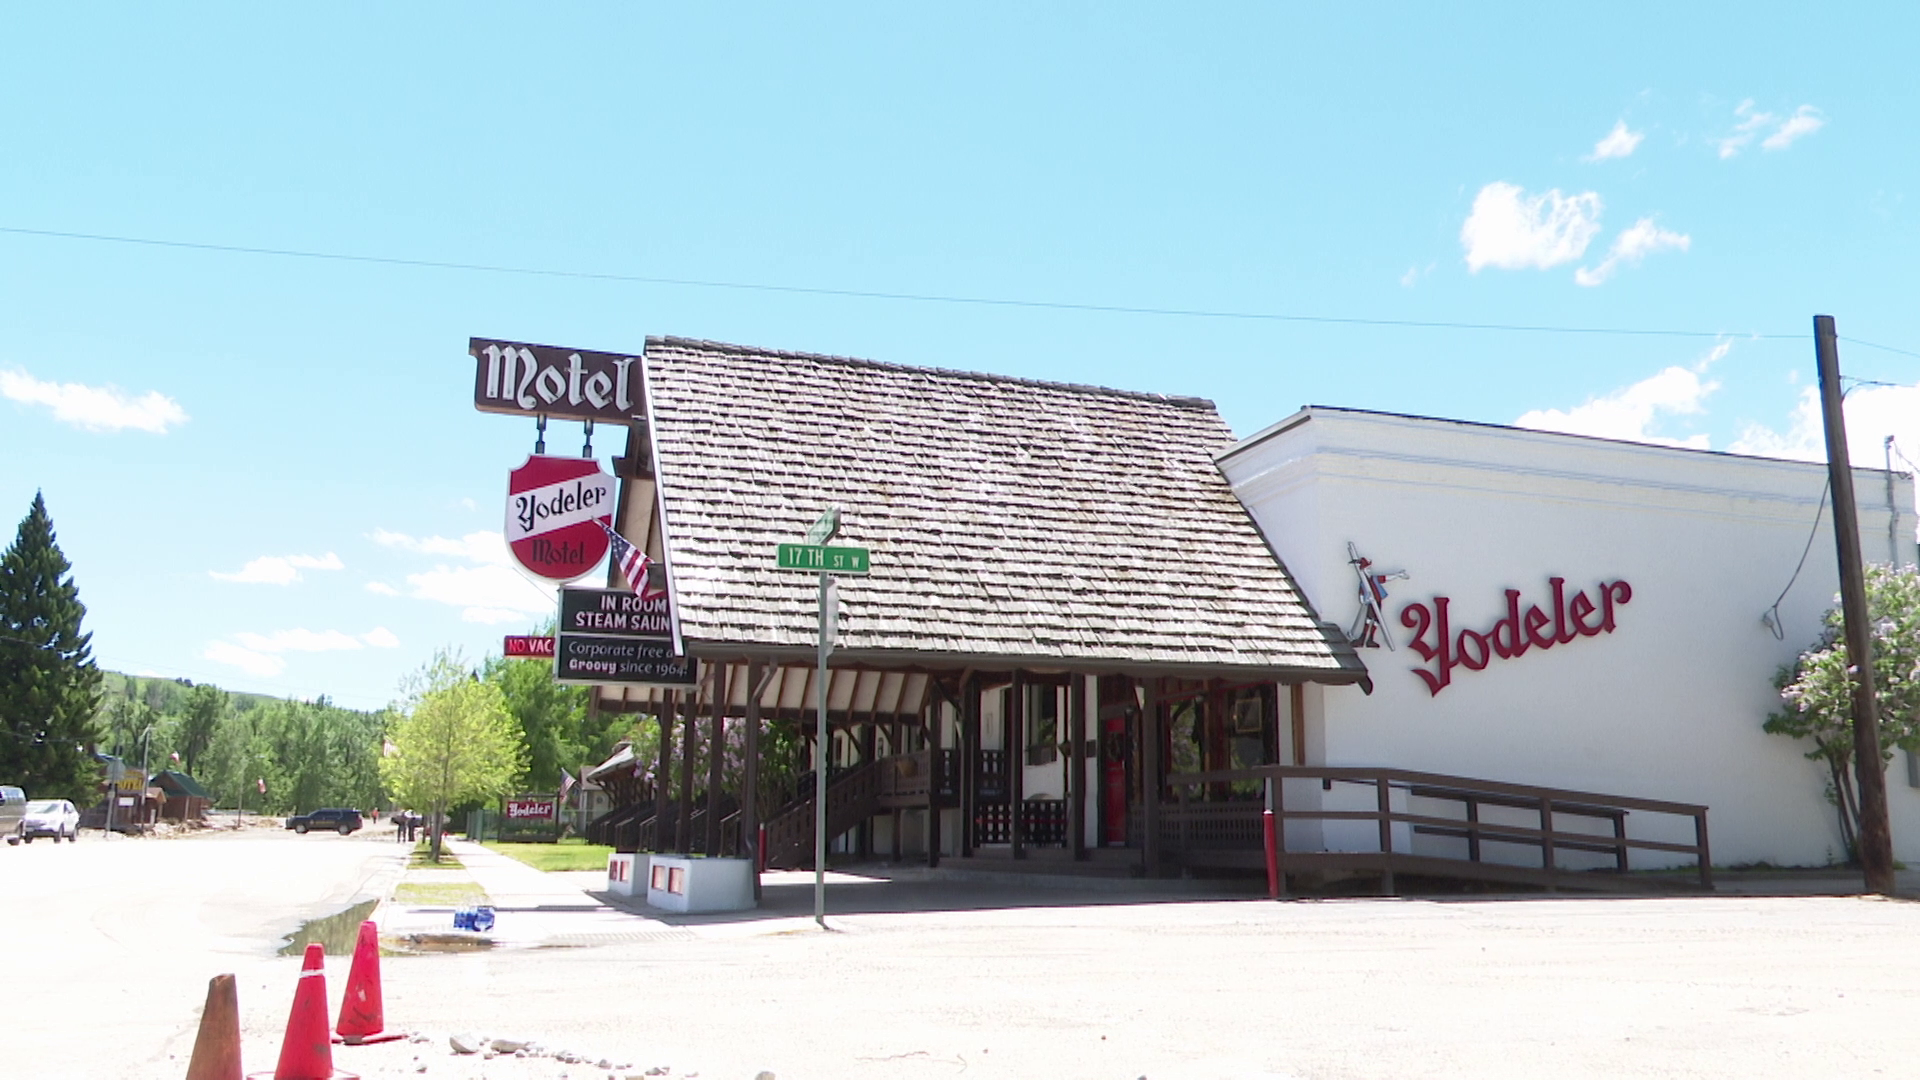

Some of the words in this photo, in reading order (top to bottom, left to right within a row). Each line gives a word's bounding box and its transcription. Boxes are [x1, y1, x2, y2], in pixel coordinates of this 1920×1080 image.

[482, 344, 635, 412] Motel
[516, 481, 607, 533] Yodeler
[532, 538, 585, 566] Motel
[788, 547, 802, 565] 17
[807, 548, 824, 567] TH
[833, 555, 844, 567] ST
[851, 556, 860, 569] W
[601, 595, 616, 611] IN
[622, 597, 667, 613] ROOM
[575, 611, 627, 629] STEAM
[509, 639, 525, 652] NO
[529, 639, 555, 652] VAC
[1400, 577, 1632, 697] Yodeler
[568, 641, 635, 657] Corporate
[636, 643, 662, 659] free
[569, 659, 617, 675] Groovy
[619, 660, 653, 675] since
[509, 803, 551, 818] Yodeler
